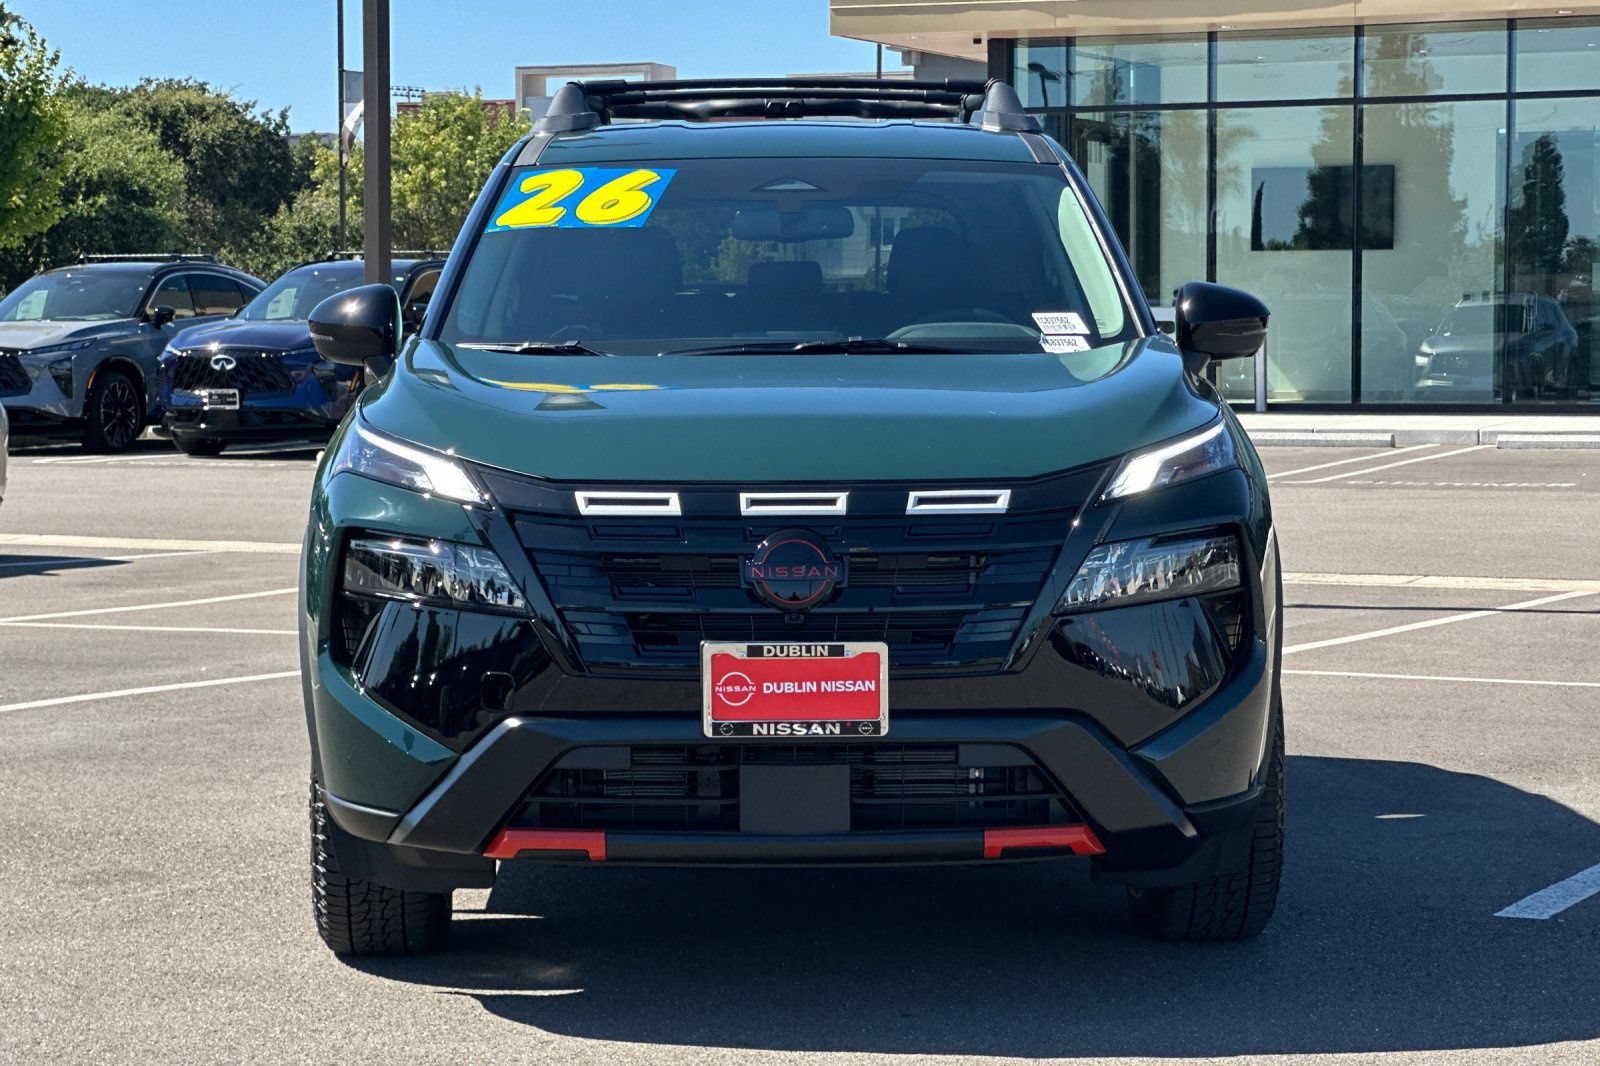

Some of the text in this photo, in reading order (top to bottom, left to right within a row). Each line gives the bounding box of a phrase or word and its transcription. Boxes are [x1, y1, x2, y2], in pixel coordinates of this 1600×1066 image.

[496, 169, 661, 227] 26
[751, 566, 837, 577] NISSAN
[763, 645, 829, 657] DUBLIN
[715, 684, 756, 692] NISSAN
[762, 680, 876, 694] DUBLIN NISSAN
[752, 723, 840, 735] NISSAN
